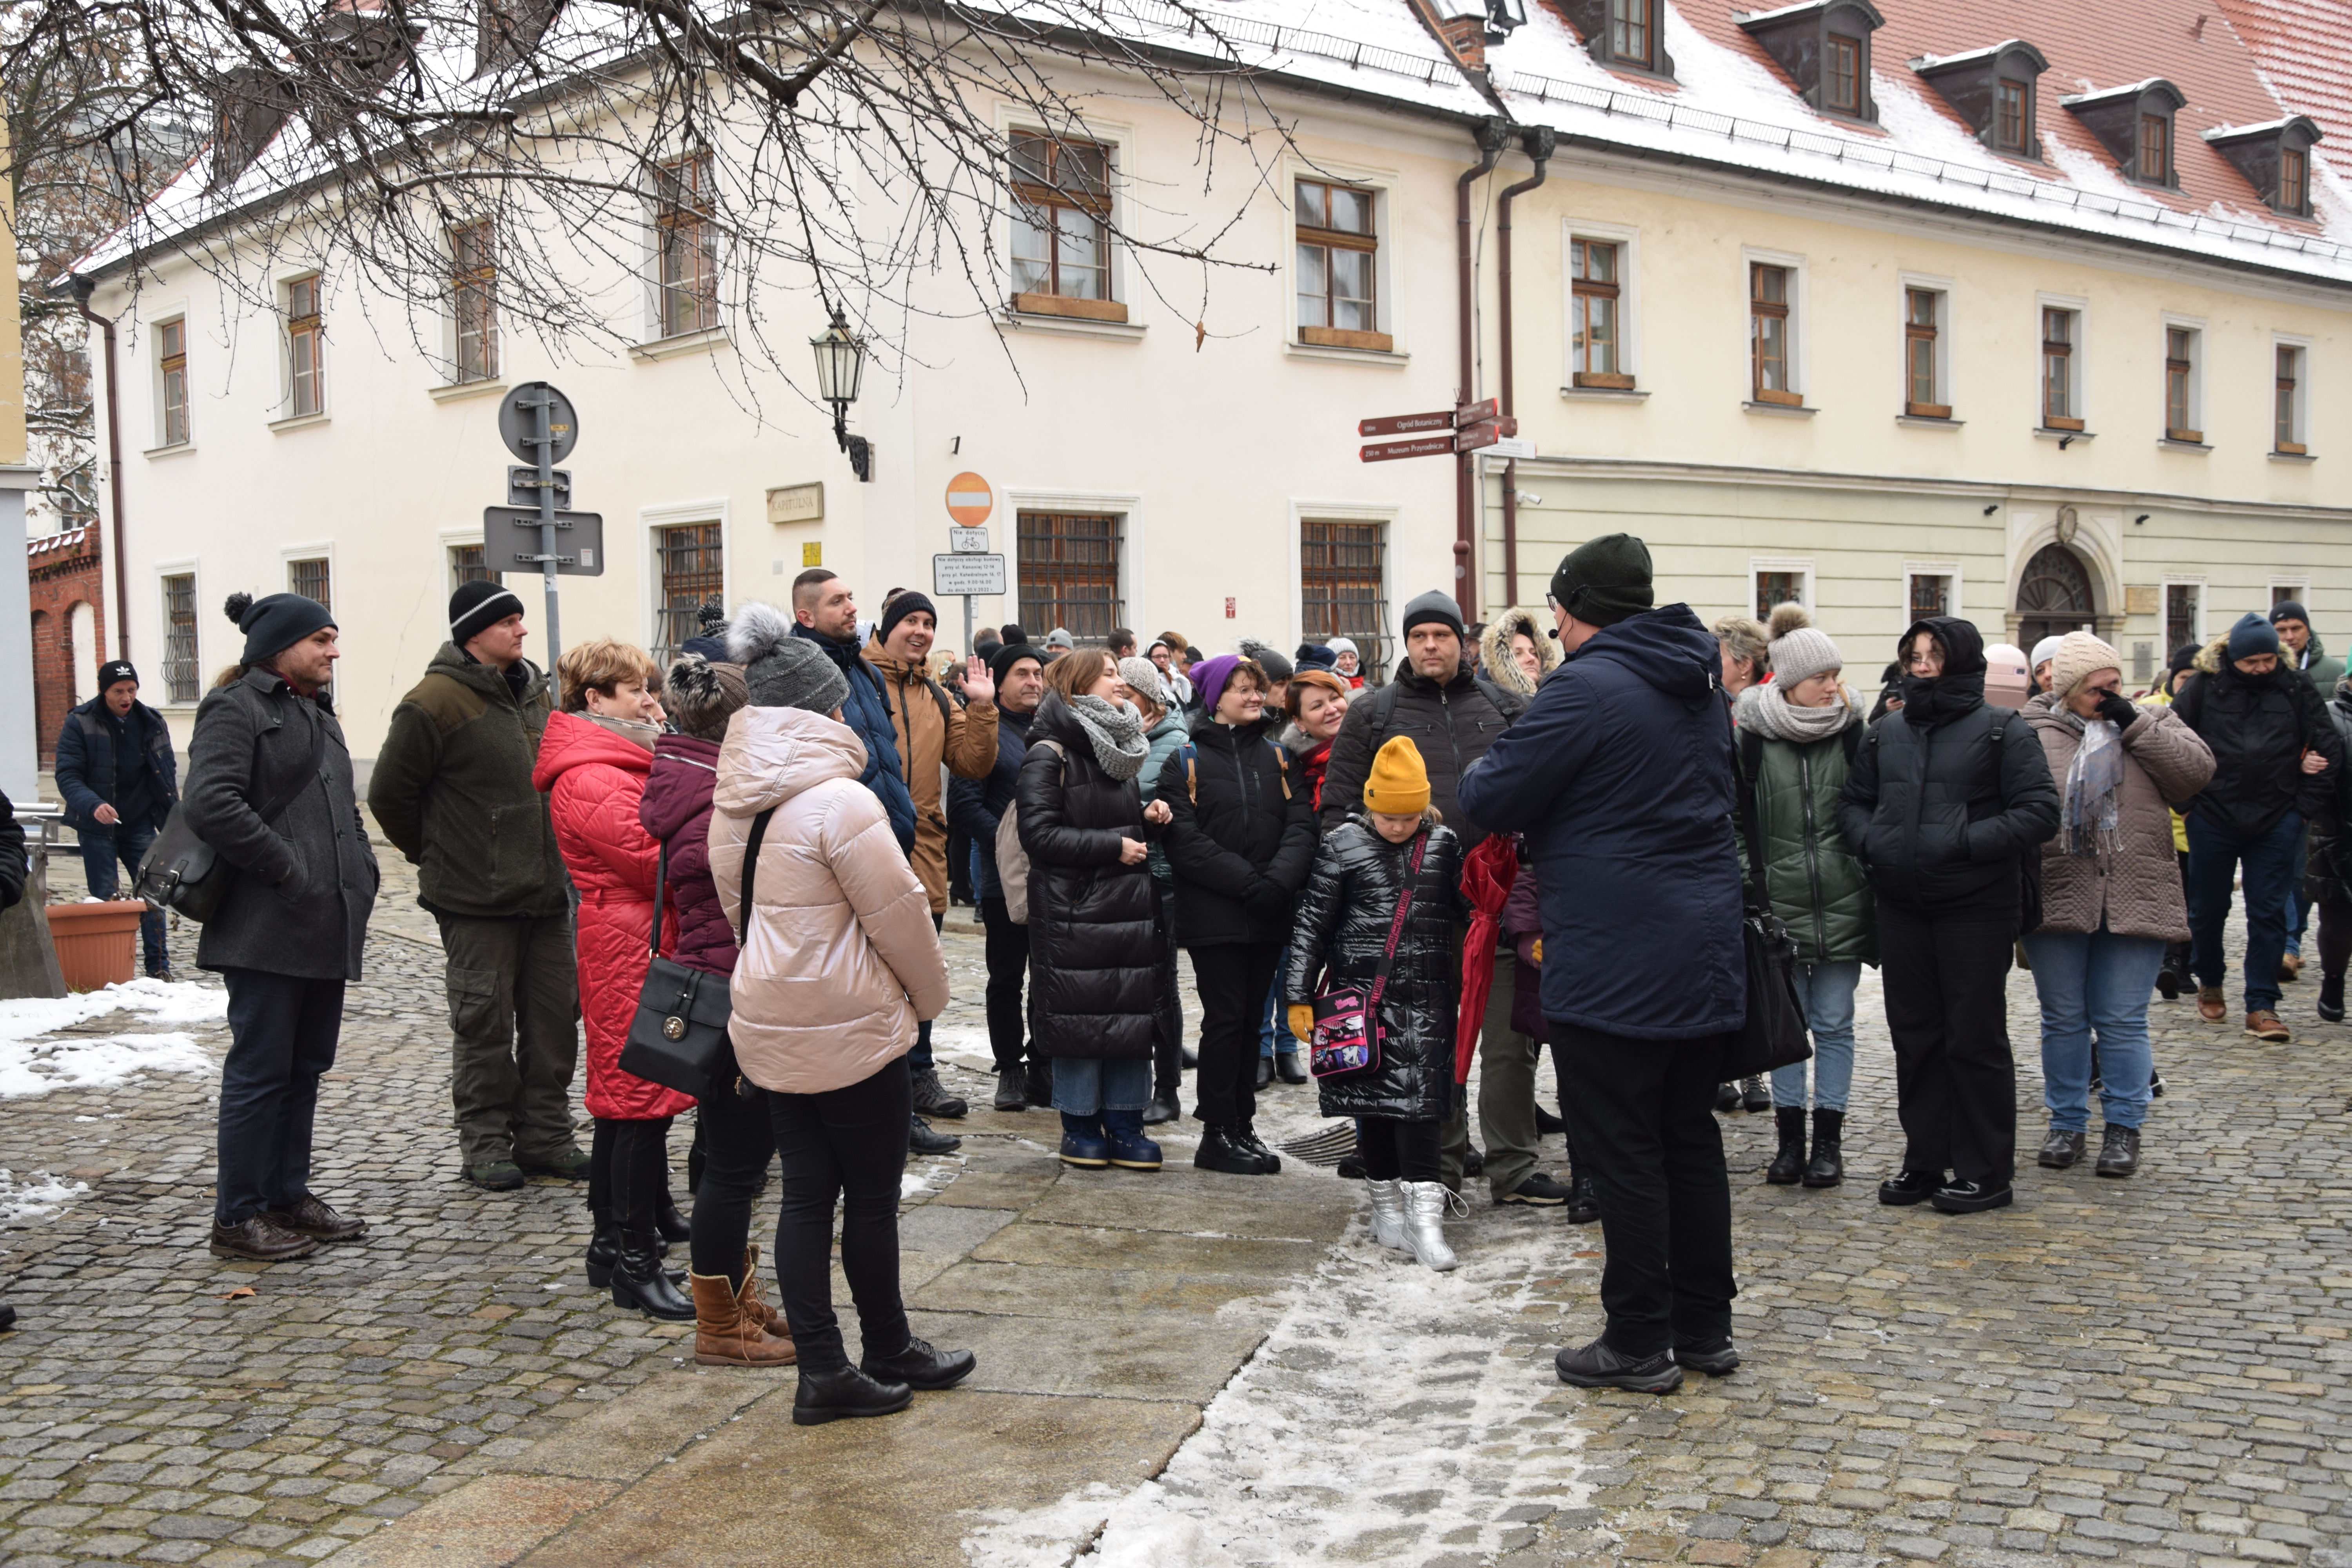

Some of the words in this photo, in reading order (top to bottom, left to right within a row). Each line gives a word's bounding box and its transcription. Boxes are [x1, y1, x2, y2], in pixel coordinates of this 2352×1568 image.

[1397, 420, 1414, 430] Ogród
[1415, 419, 1443, 428] Botaniczny
[1411, 443, 1445, 453] Przyrodnicze
[772, 497, 813, 511] KAPITULNA
